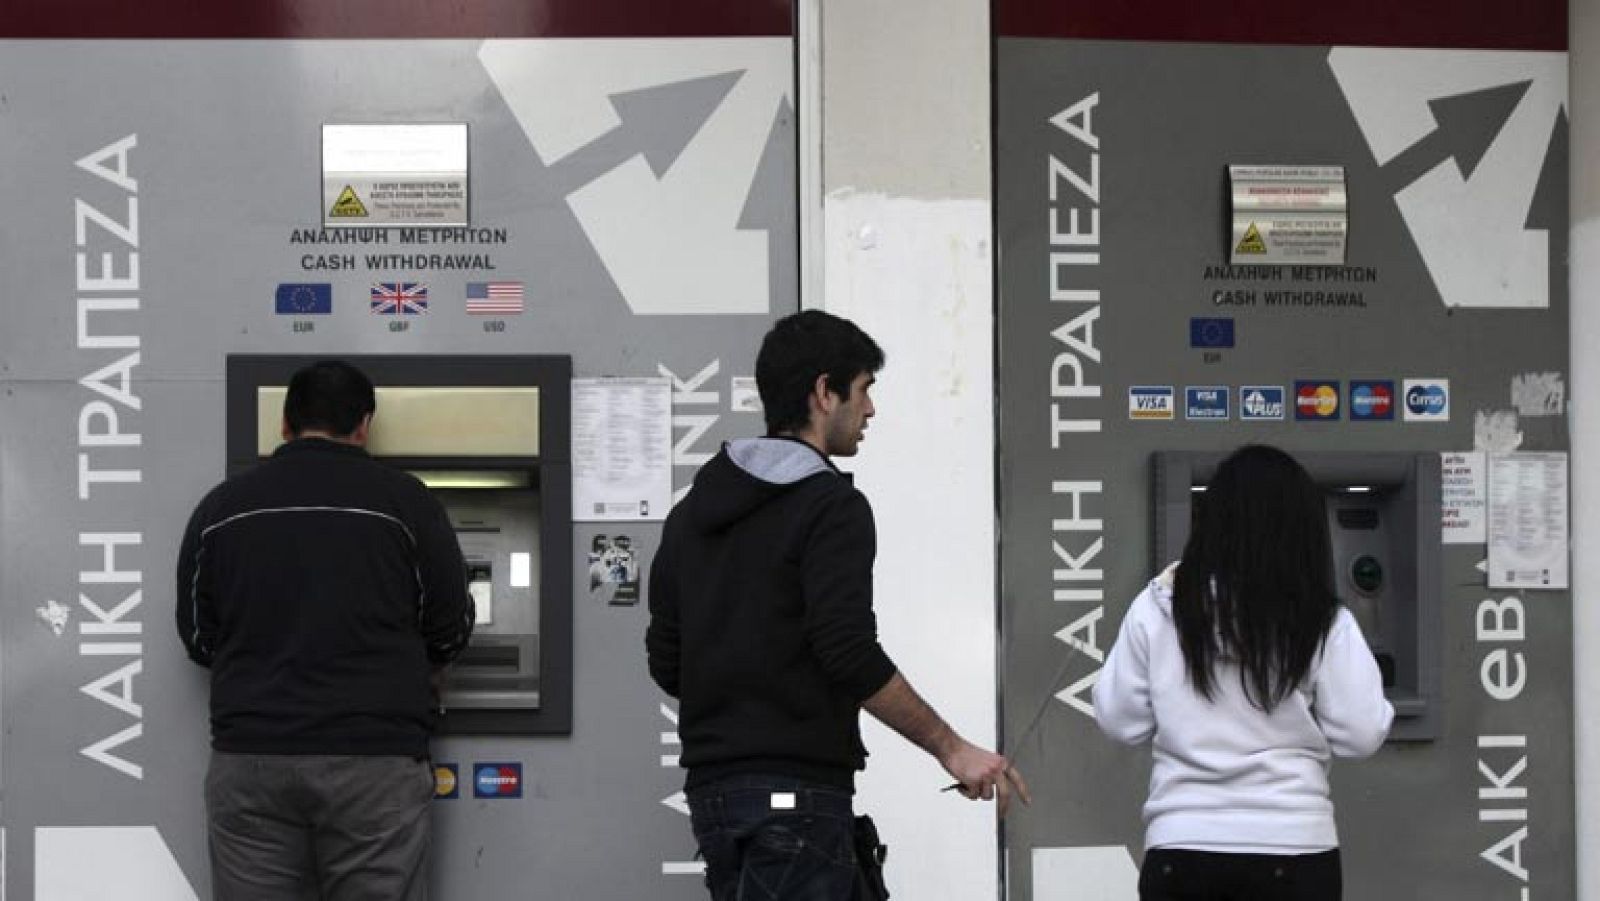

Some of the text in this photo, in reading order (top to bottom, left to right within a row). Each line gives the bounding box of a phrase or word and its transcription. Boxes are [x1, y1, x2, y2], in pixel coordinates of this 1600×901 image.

[290, 228, 508, 244] ΑΝΑΛΗΨΗ ΜΕΤΡΗΤΩΝ
[301, 254, 496, 270] CASH WITHDRAWAL
[1048, 91, 1103, 449] ΤΡΑΠΕΖΑ
[1203, 266, 1377, 282] ΑΝΑΛΗΨΗ ΜΕΤΡΗΤΩΝ
[1212, 290, 1368, 307] CASH WITHDRAWAL
[74, 133, 143, 500] ΤΡΑΠΕΖΑ
[293, 321, 314, 332] EUR
[1136, 396, 1167, 410] VISA
[1252, 402, 1282, 416] PLUS
[1477, 735, 1529, 901] AIKI
